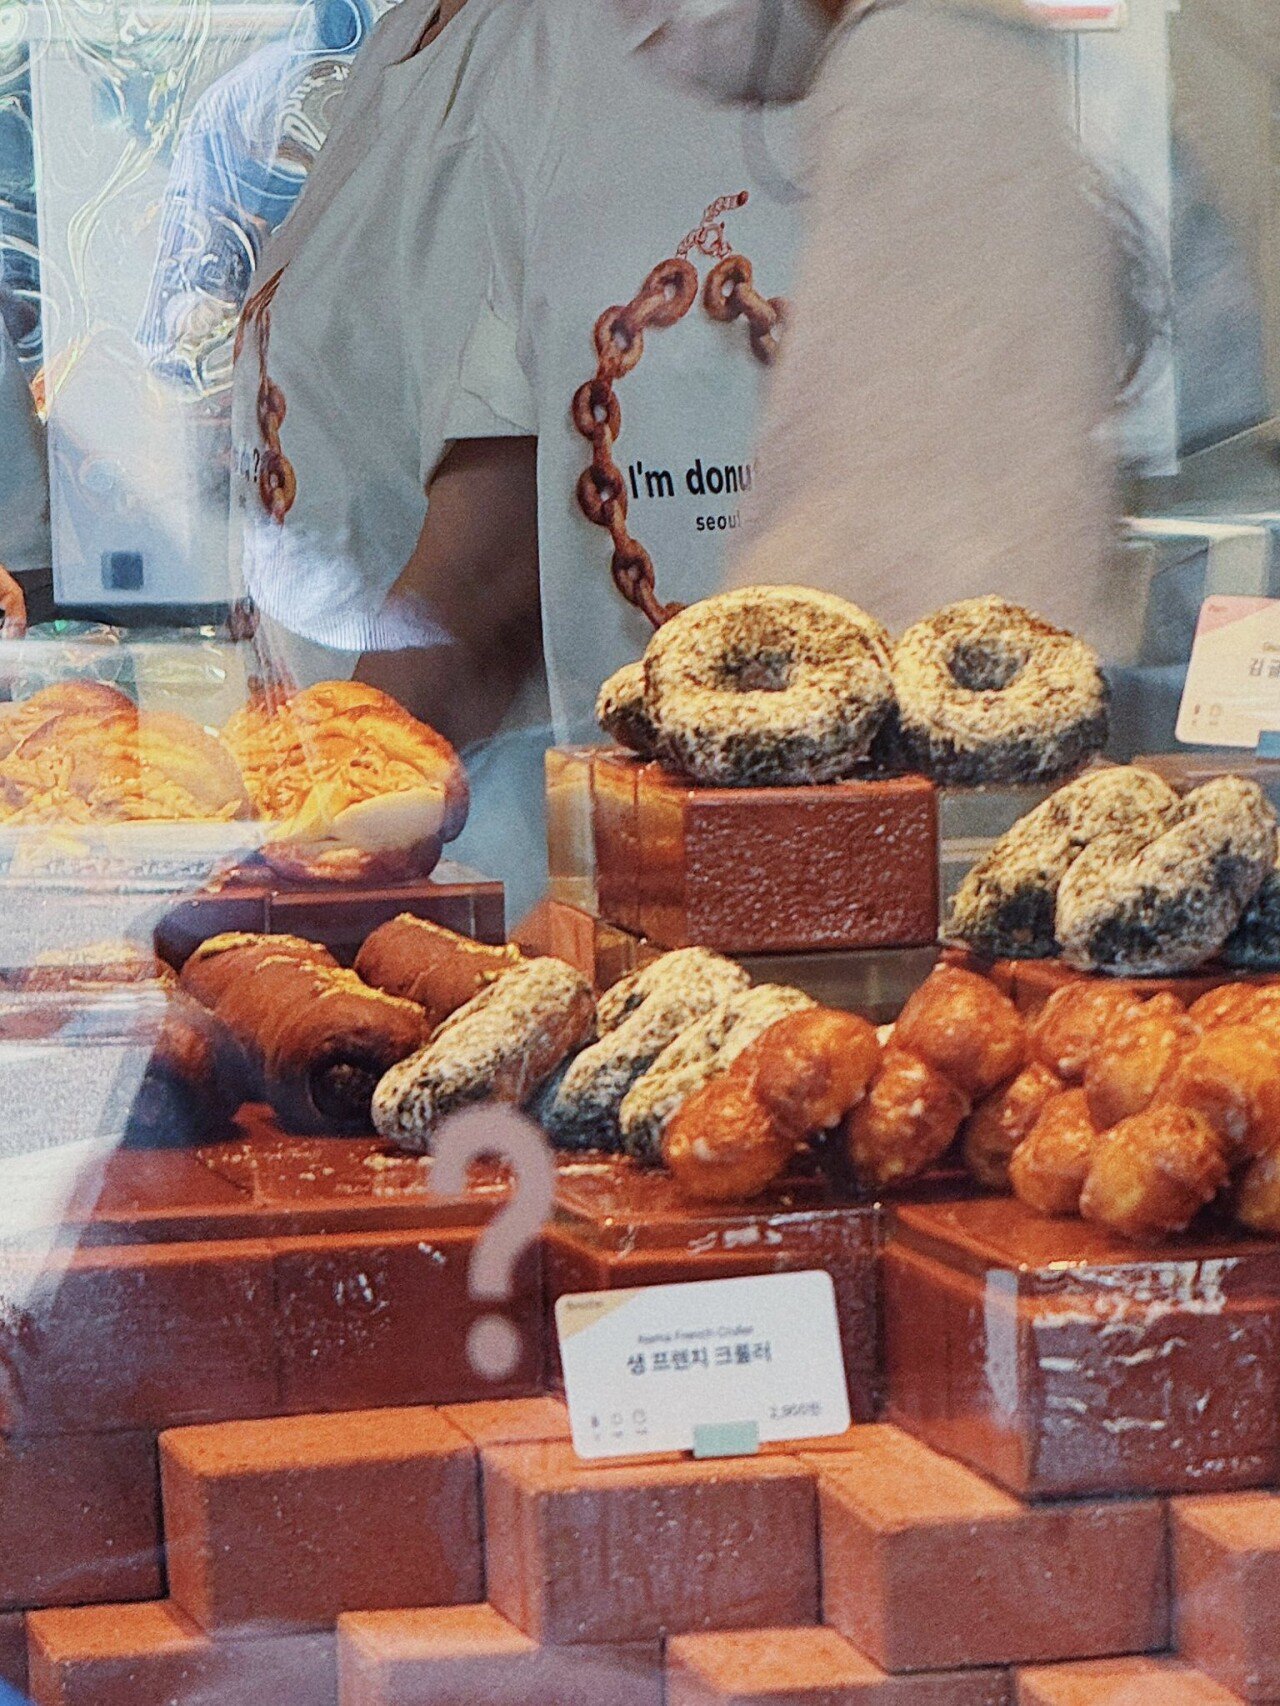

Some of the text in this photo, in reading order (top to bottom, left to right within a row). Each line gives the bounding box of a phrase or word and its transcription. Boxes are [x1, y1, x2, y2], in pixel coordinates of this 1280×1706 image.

[628, 458, 758, 499] I'm donu
[429, 1103, 554, 1381] ?
[627, 1351, 646, 1375] 생
[652, 1347, 708, 1371] 프렌치
